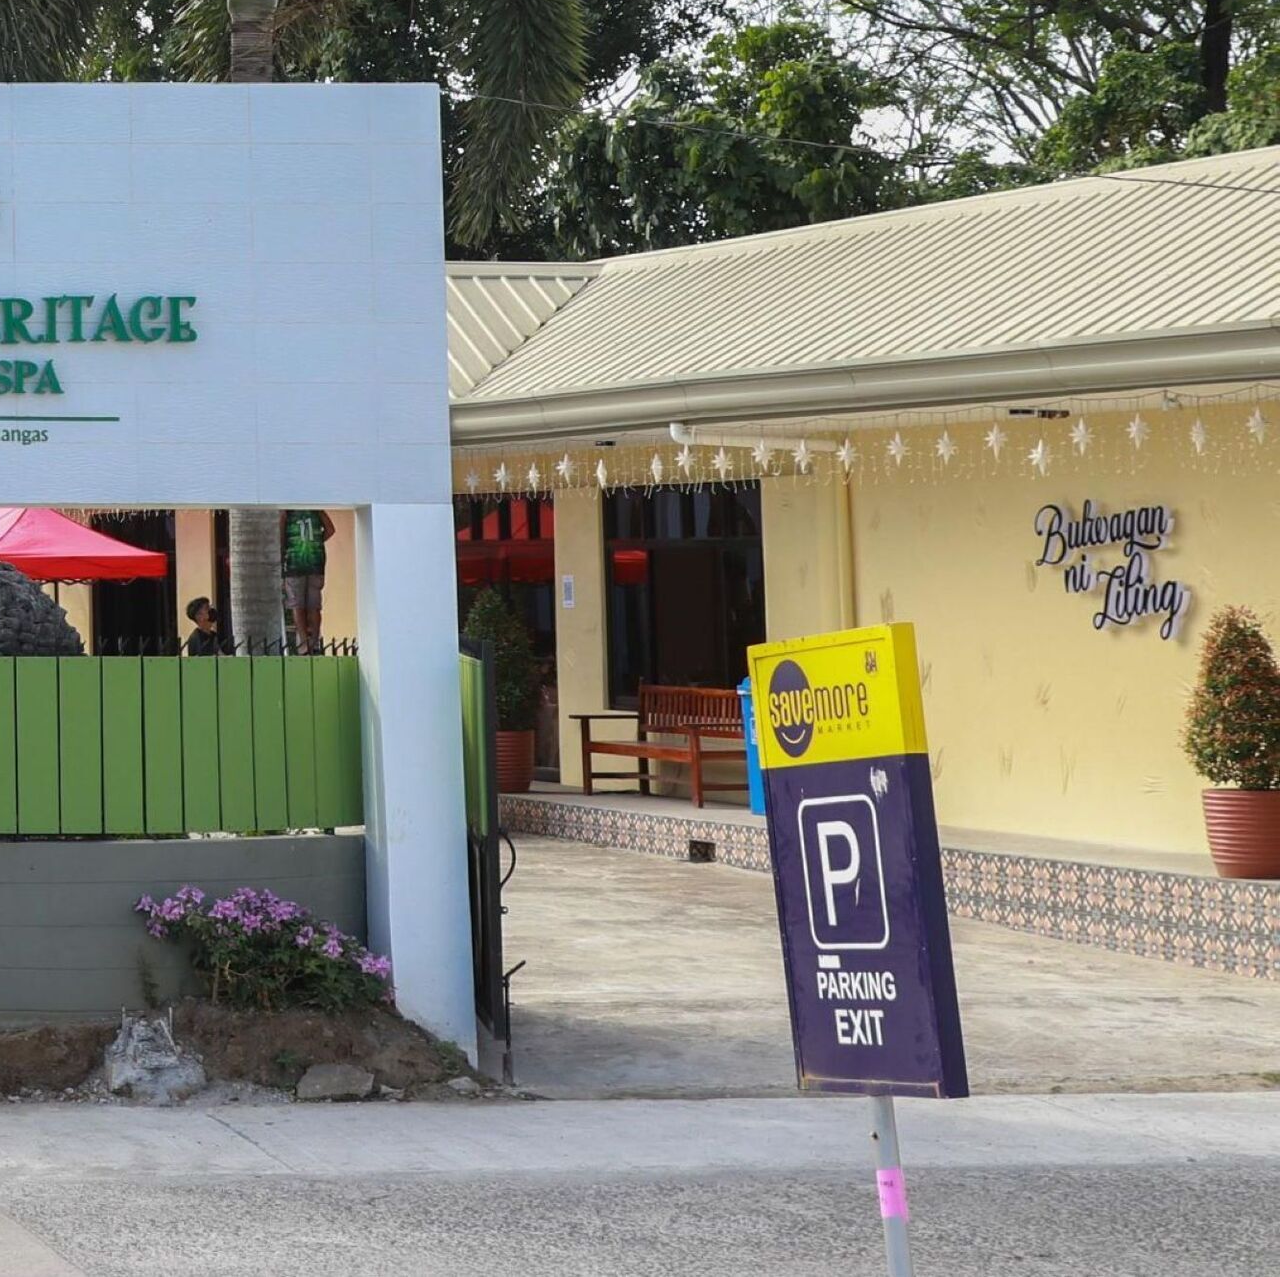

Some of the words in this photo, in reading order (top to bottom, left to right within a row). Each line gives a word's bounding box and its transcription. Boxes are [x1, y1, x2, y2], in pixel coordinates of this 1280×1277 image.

[1064, 554, 1091, 593] ni
[1093, 552, 1184, 640] Liling
[817, 720, 871, 734] MARKET
[817, 821, 861, 926] P
[816, 972, 897, 1000] PARKING
[835, 1009, 884, 1046] EXIT
